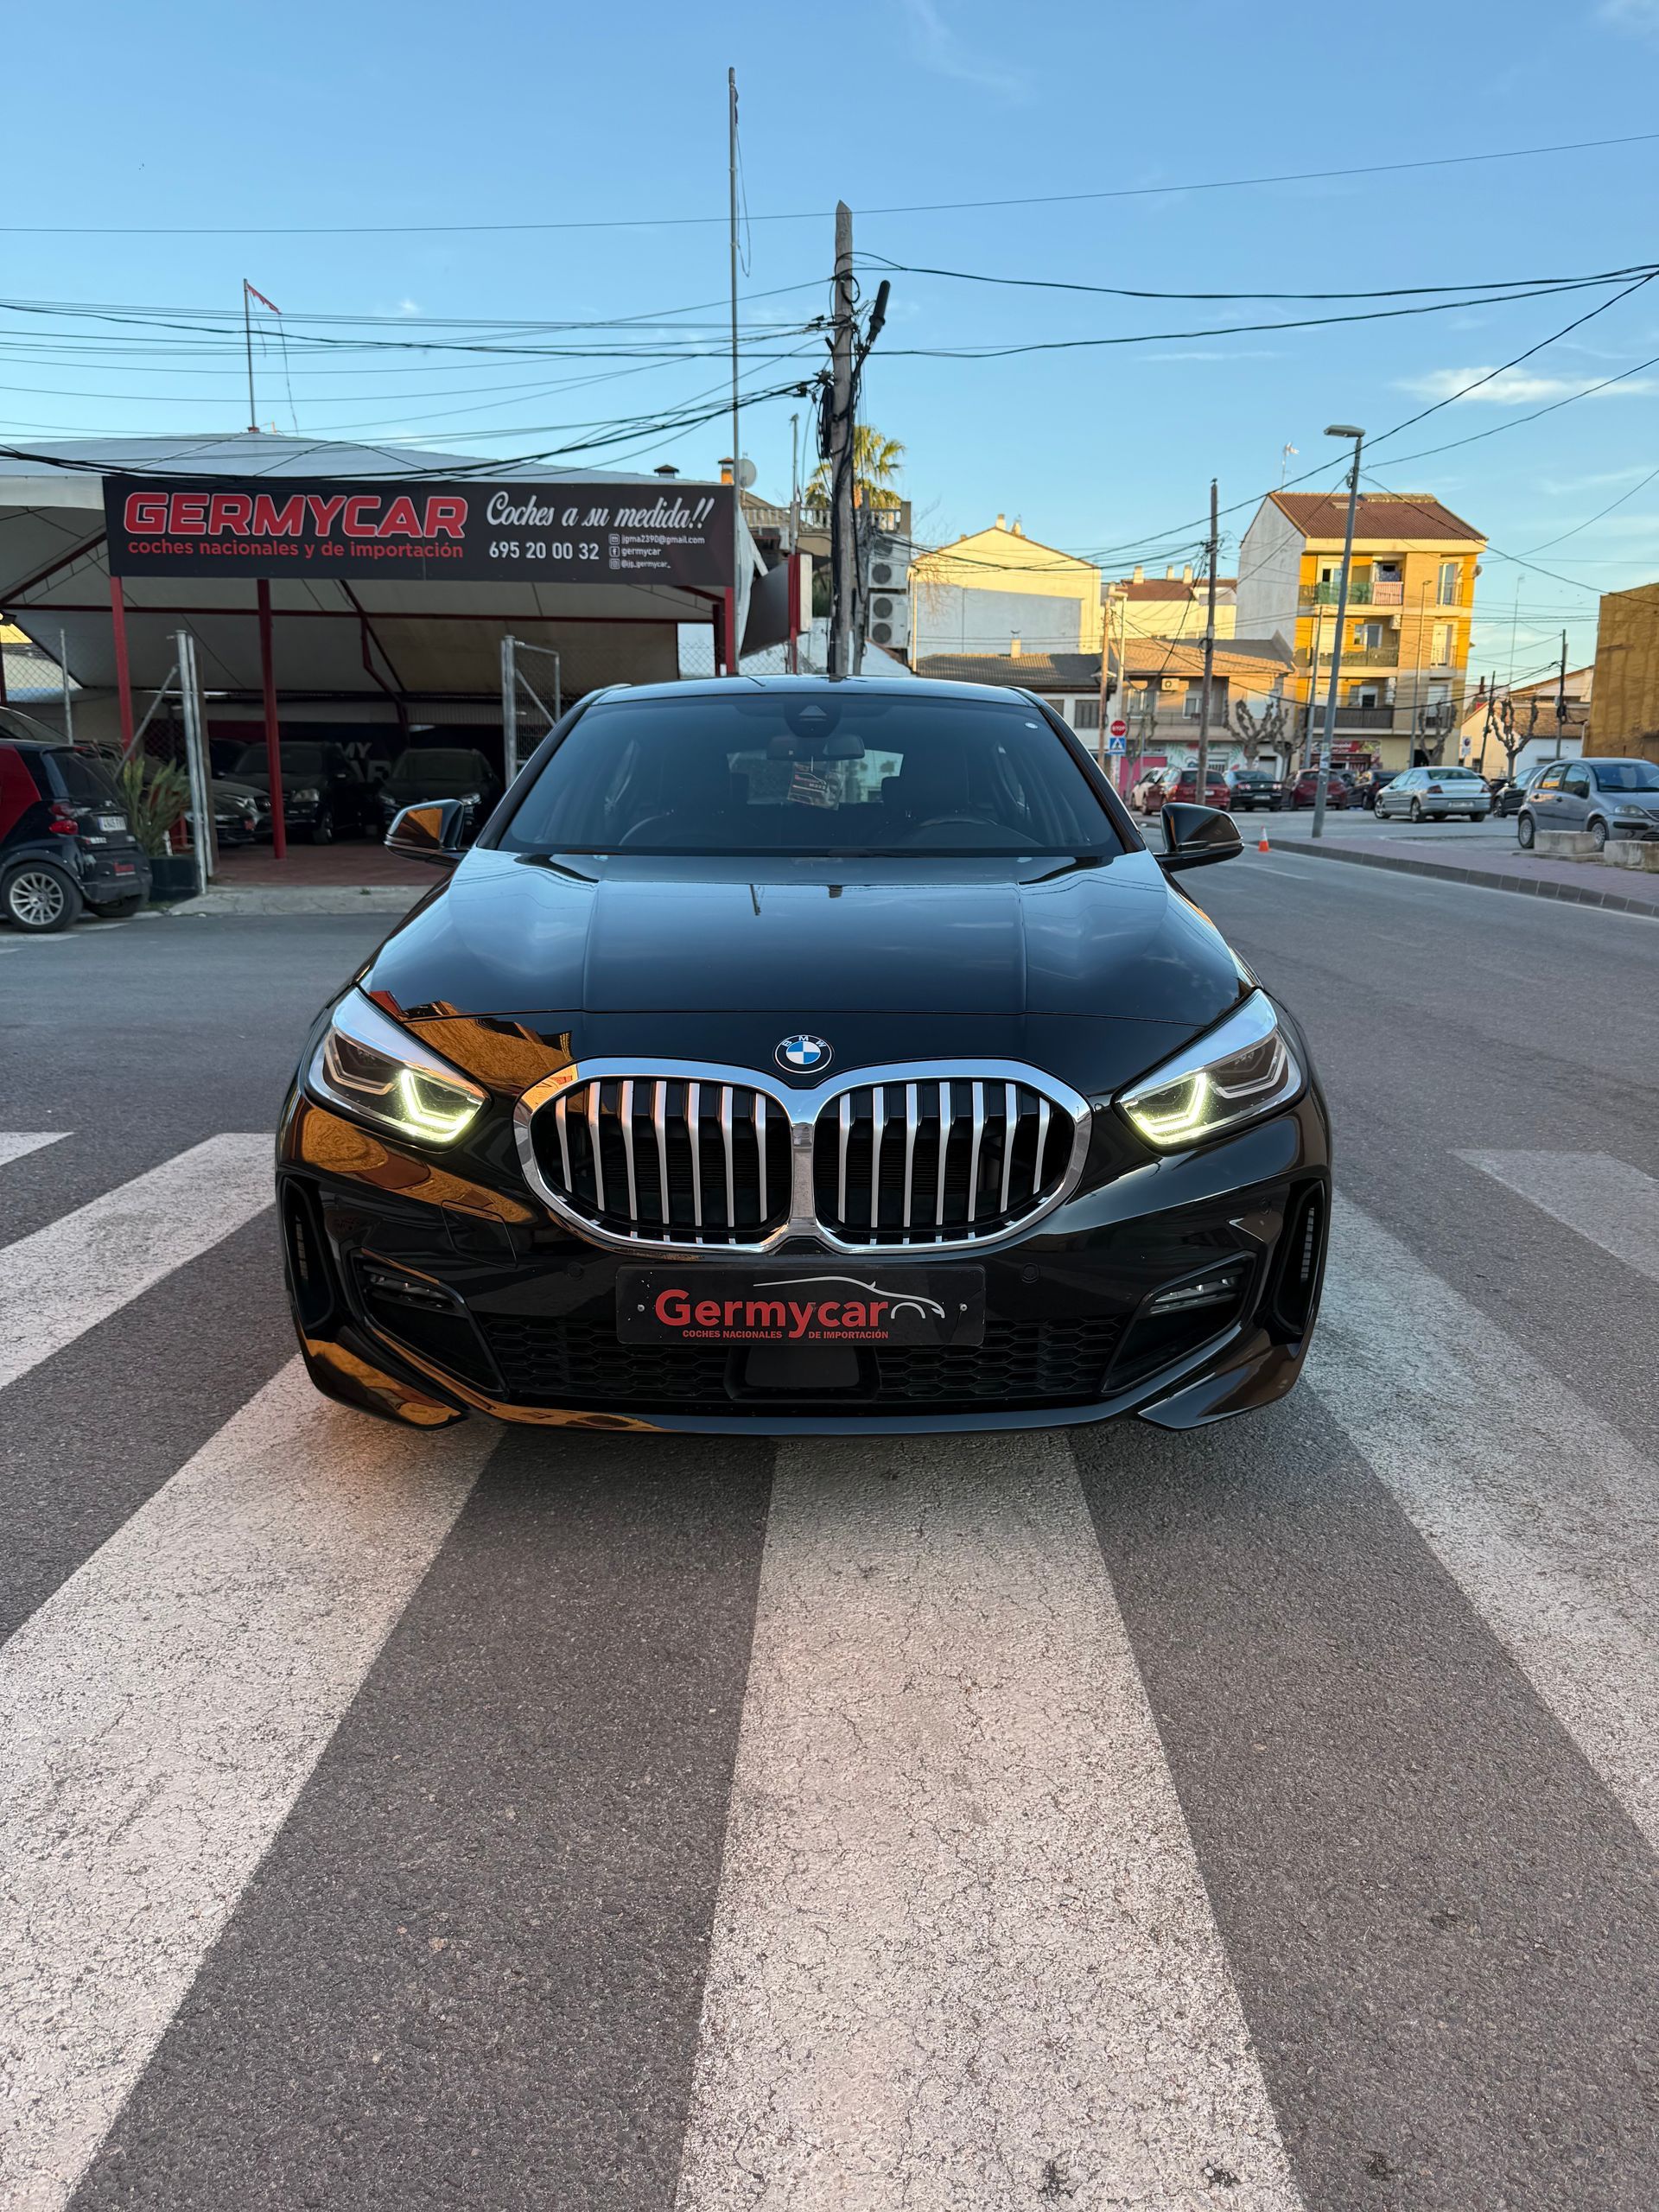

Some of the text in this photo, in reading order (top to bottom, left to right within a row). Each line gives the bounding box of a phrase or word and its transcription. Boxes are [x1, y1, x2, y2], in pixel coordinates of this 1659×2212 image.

[124, 492, 468, 539] GERMYCAR
[486, 491, 715, 529] Coches a su medida!!
[128, 539, 463, 560] coches nacionales y de importación
[489, 541, 600, 561] 695 20 00 32
[621, 548, 662, 557] germycar
[781, 1035, 827, 1048] BMW
[655, 1288, 888, 1338] Germycar
[683, 1329, 888, 1339] COCHES NACIONALES DE IMPORTACIÓN
